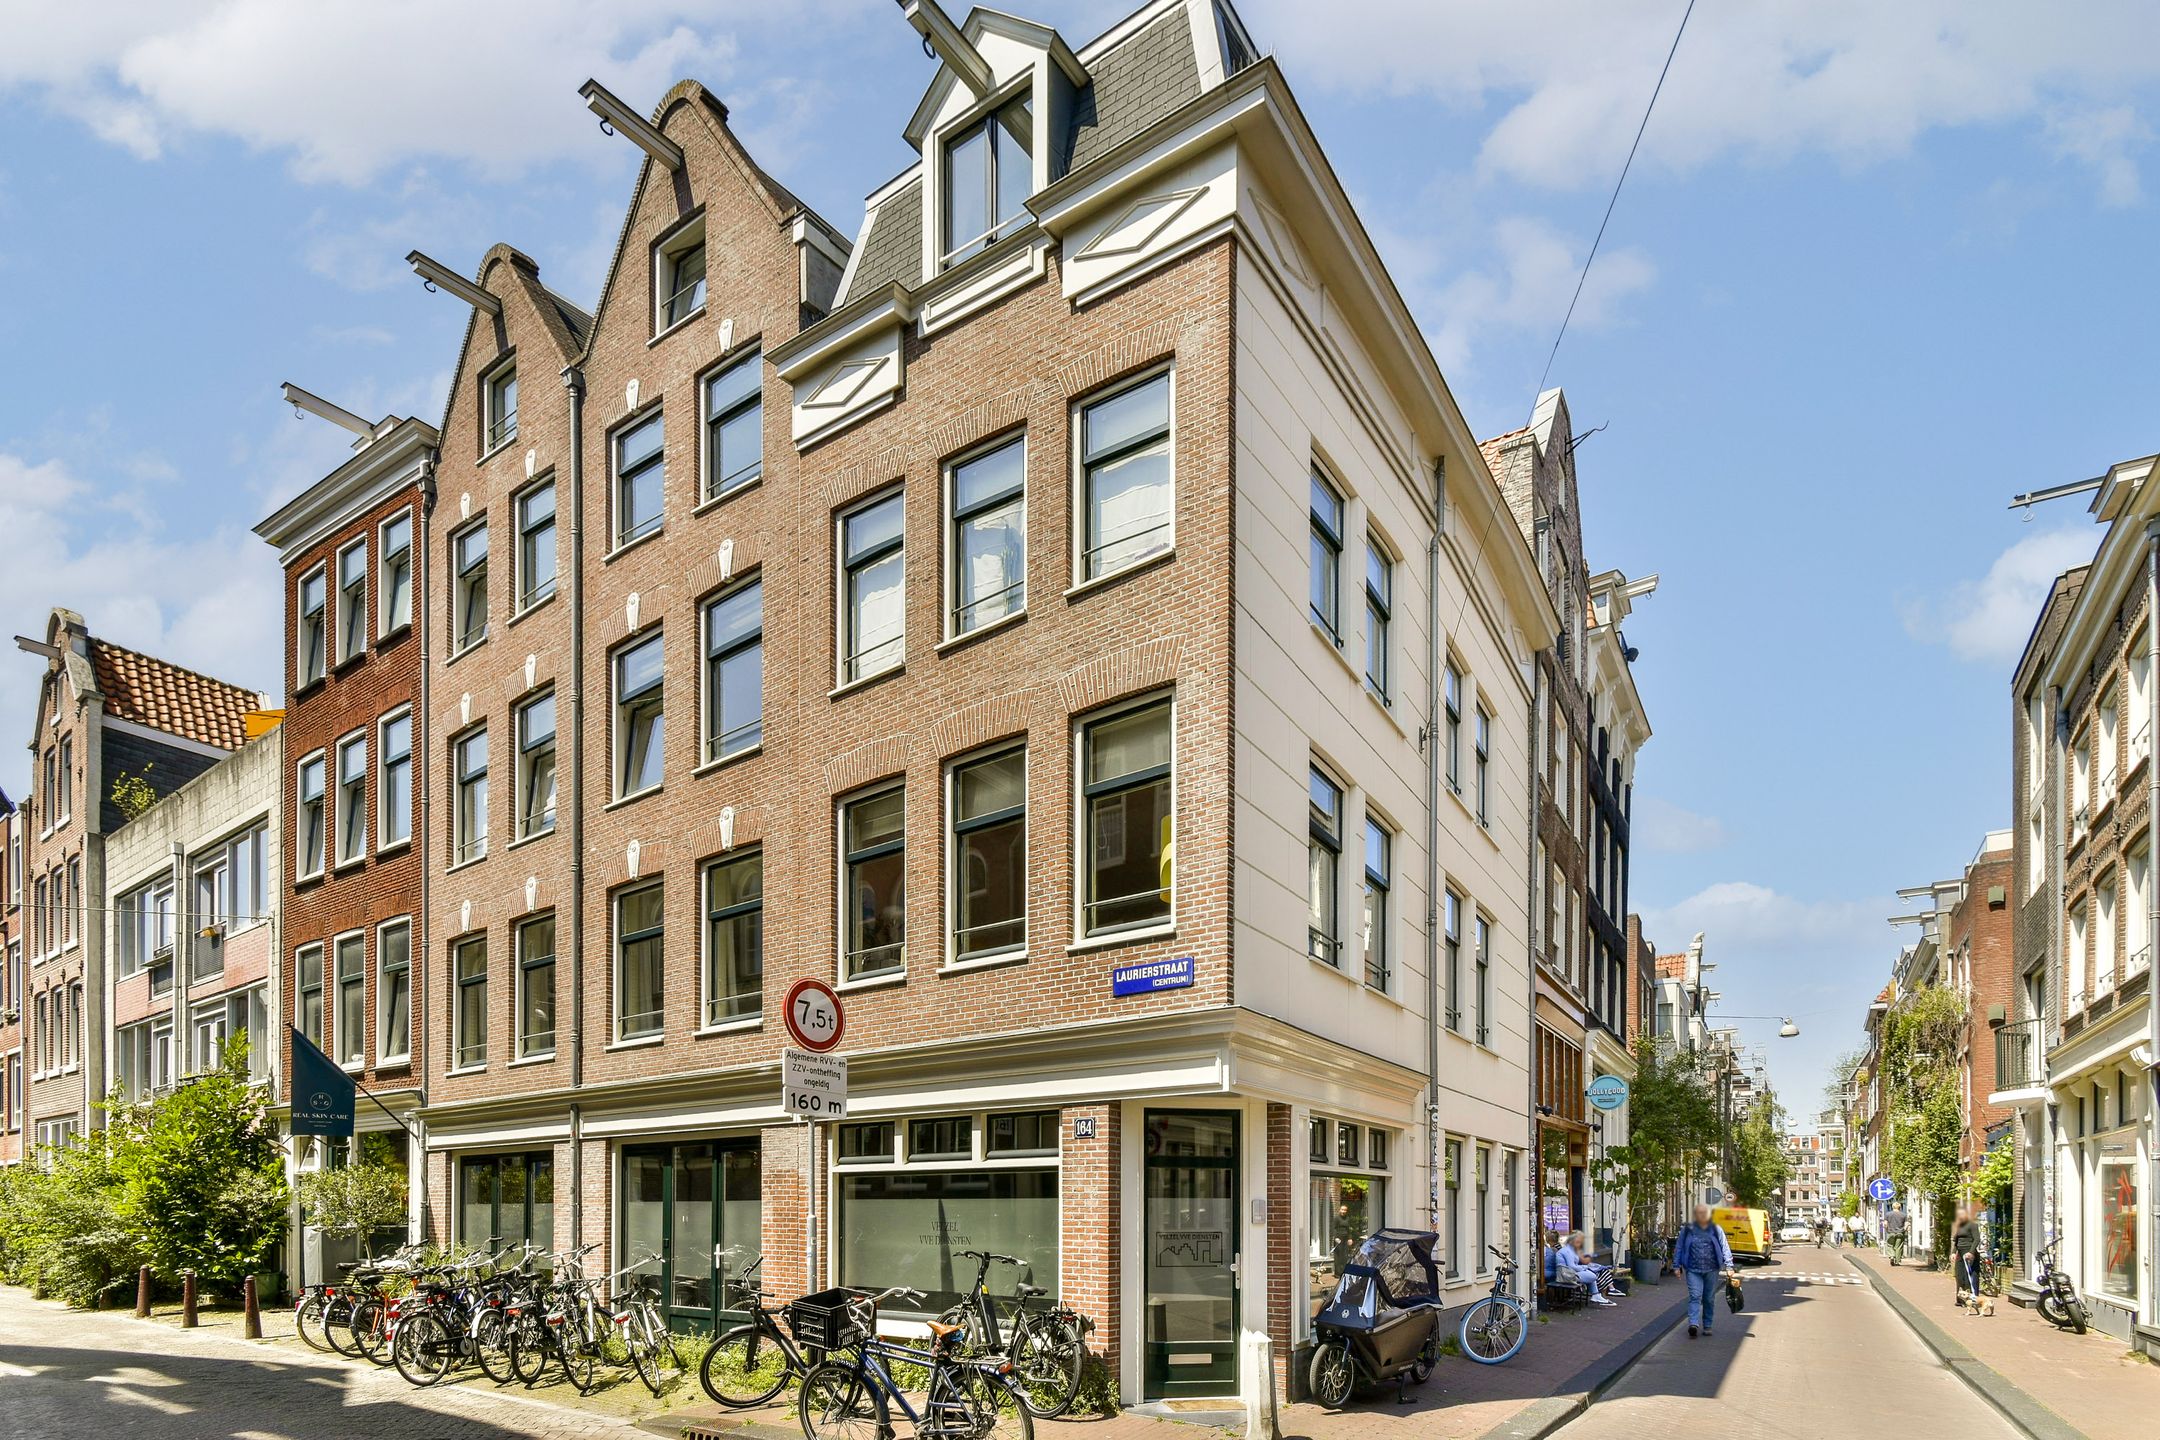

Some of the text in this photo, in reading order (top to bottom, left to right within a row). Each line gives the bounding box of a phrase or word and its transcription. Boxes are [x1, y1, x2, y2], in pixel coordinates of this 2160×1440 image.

[1116, 961, 1188, 982] LAURIERSTRAAT
[1152, 975, 1189, 987] (CENTRUM)
[786, 1051, 818, 1063] Algemene
[819, 1056, 836, 1065] RVV-
[792, 1063, 841, 1080] ZZV-ontheffing
[803, 1078, 830, 1091] ongeldig
[790, 1092, 842, 1114] 160 m
[1076, 1120, 1092, 1135] 164
[919, 1235, 934, 1245] VVE
